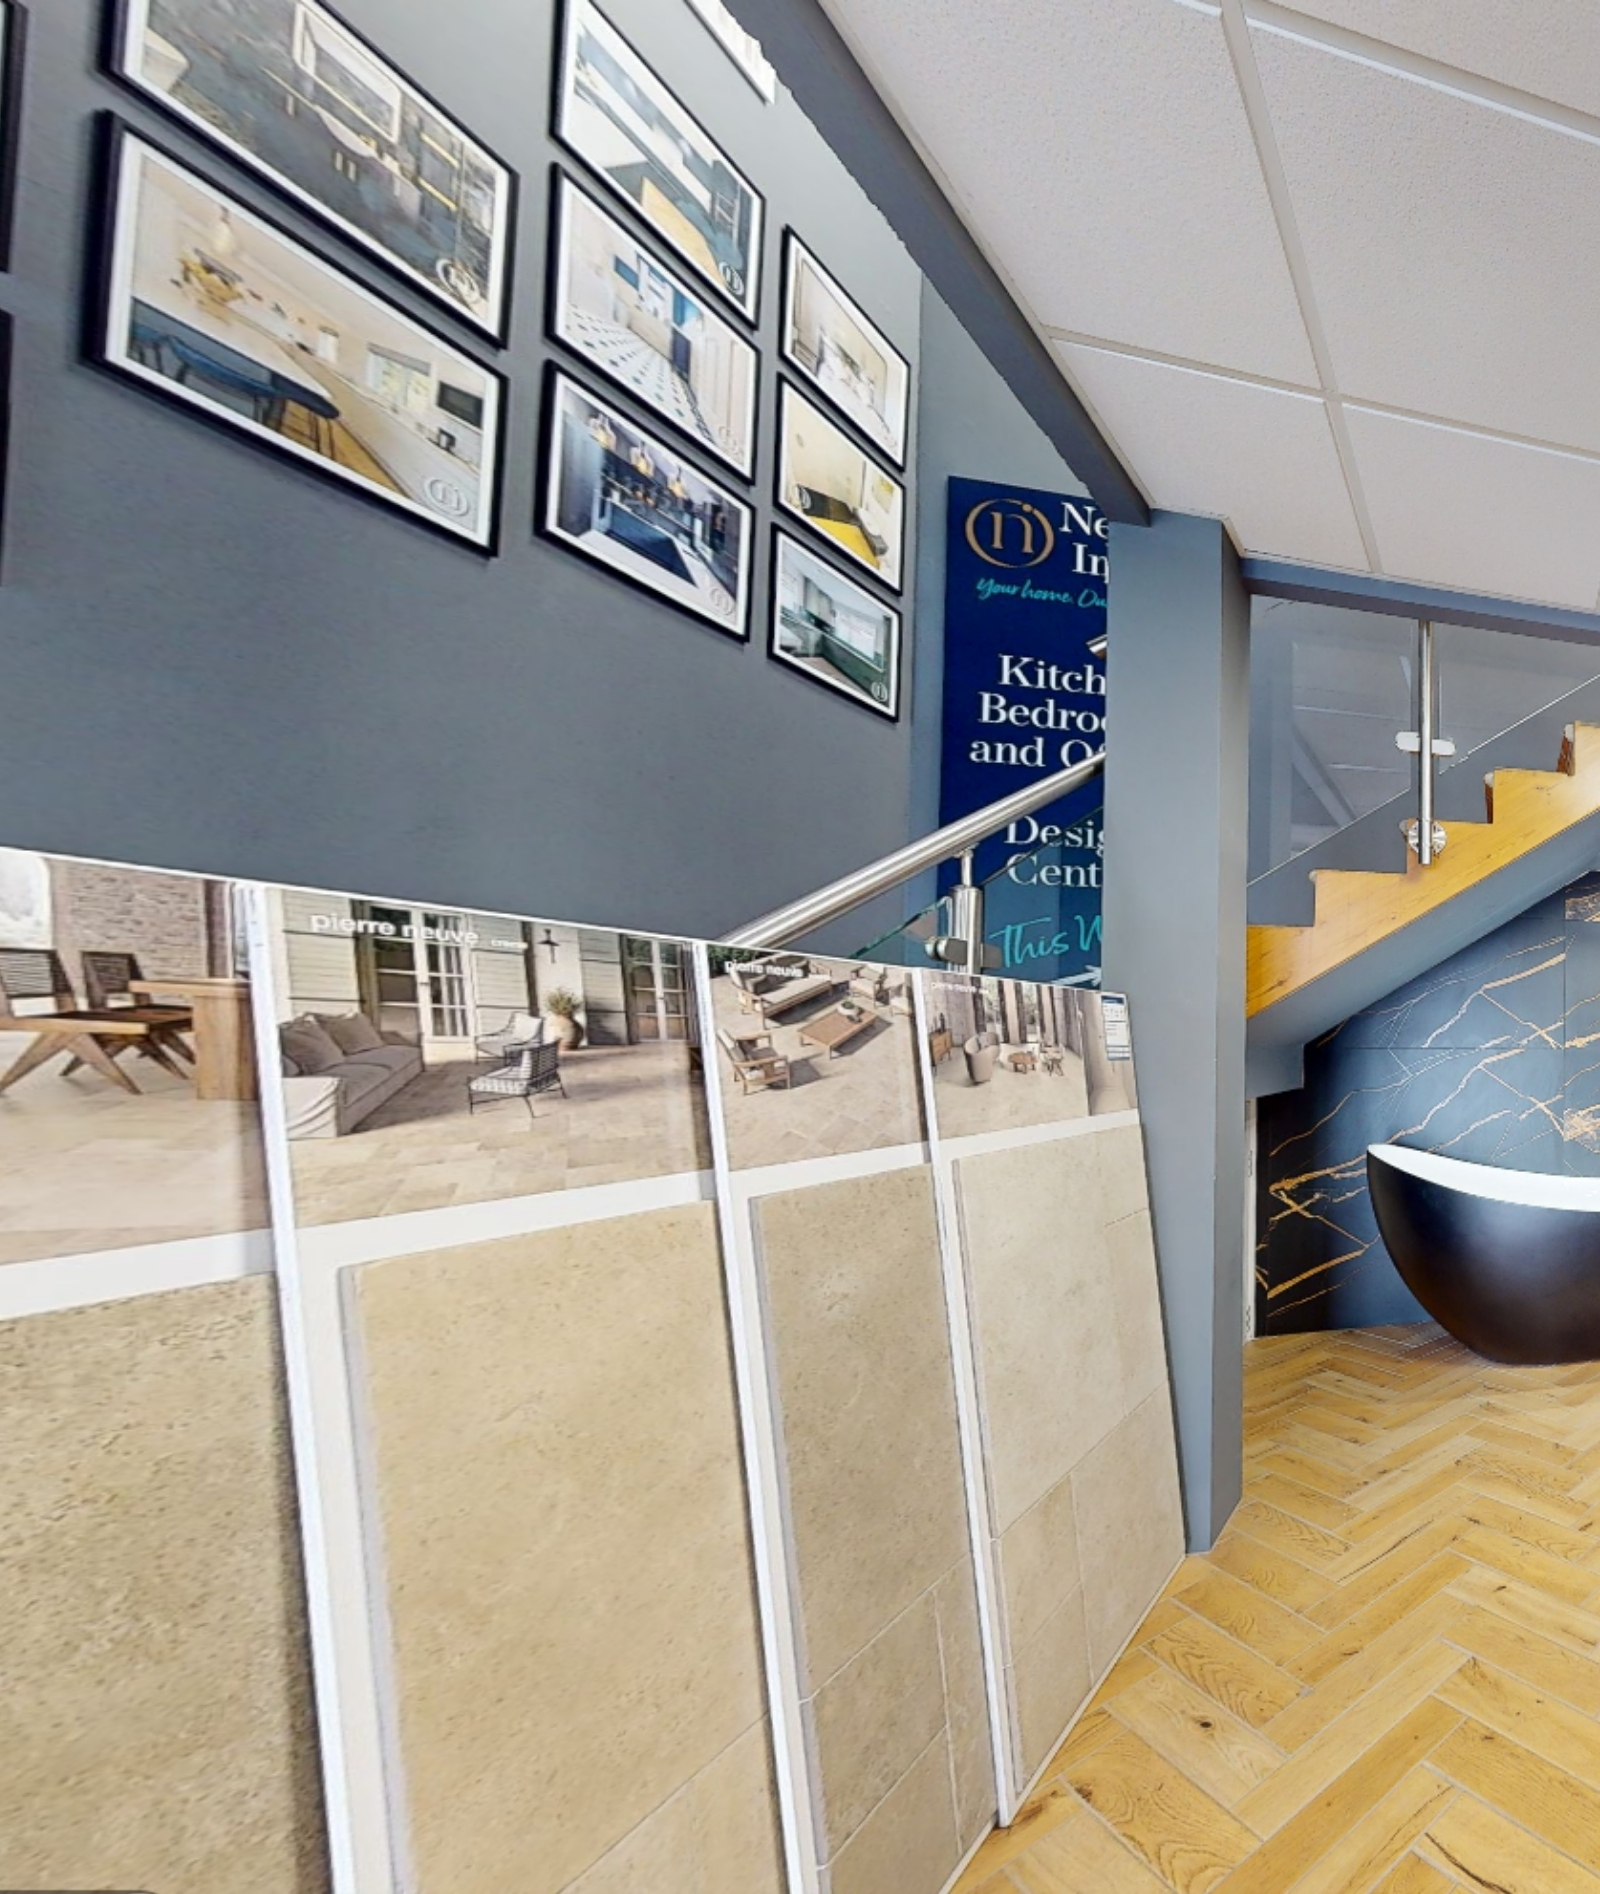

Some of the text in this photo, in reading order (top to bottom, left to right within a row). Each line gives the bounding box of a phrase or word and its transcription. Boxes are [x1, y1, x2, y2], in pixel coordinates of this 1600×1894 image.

[969, 736, 1106, 767] and O
[1006, 853, 1102, 888] Cent
[310, 913, 396, 936] pierre
[402, 922, 479, 945] neuve
[989, 917, 1069, 967] This
